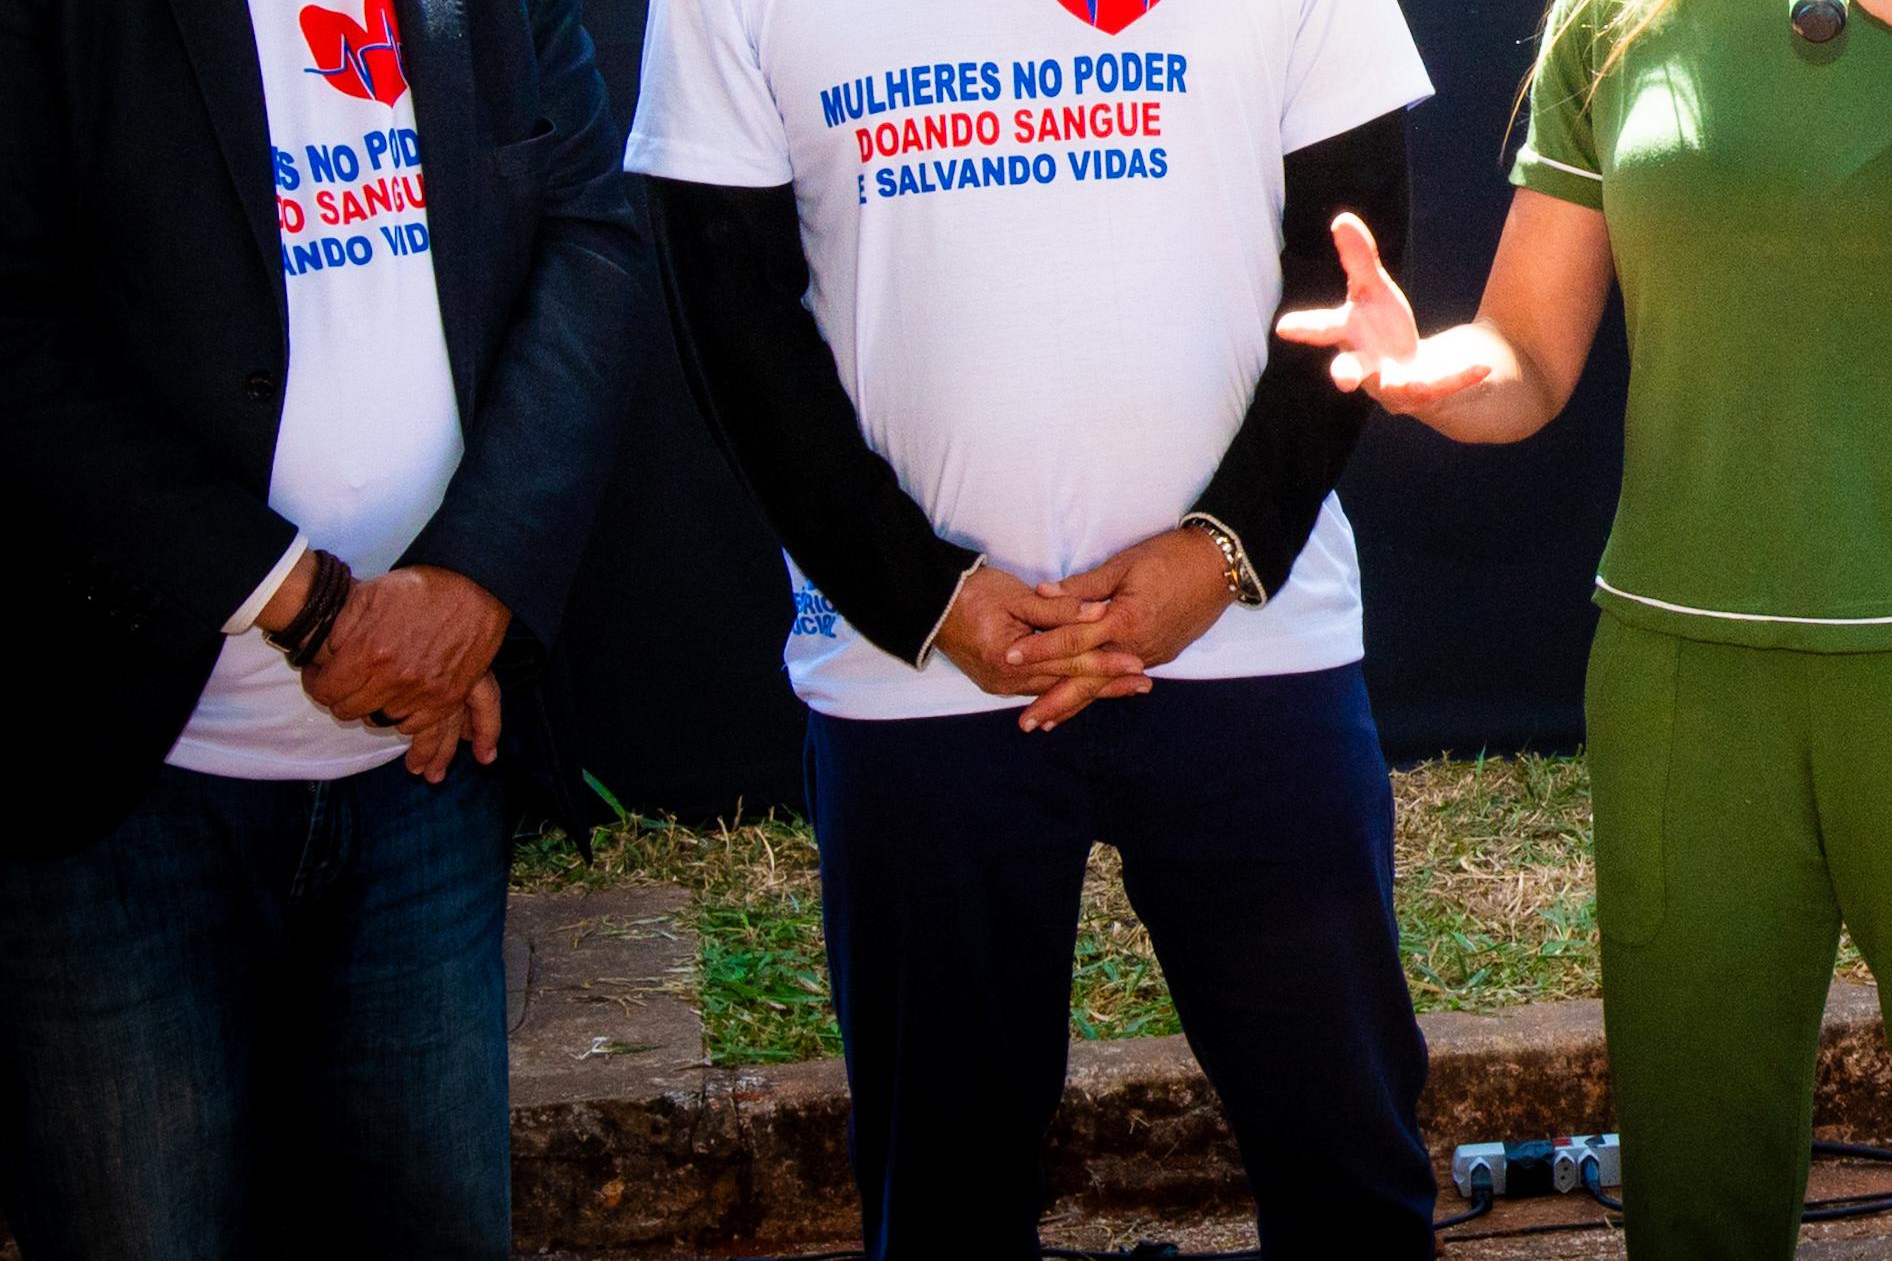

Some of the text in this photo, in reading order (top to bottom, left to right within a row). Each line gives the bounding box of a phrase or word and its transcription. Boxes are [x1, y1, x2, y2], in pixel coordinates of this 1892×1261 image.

[820, 52, 1187, 128] MULHERES NO PODER
[305, 144, 360, 183] NO
[363, 127, 423, 170] POD
[855, 102, 1161, 163] DOANDO SANGUE
[316, 173, 428, 225] SANGU
[857, 148, 1168, 205] E SALVANDO VIDAS
[380, 222, 430, 256] VID
